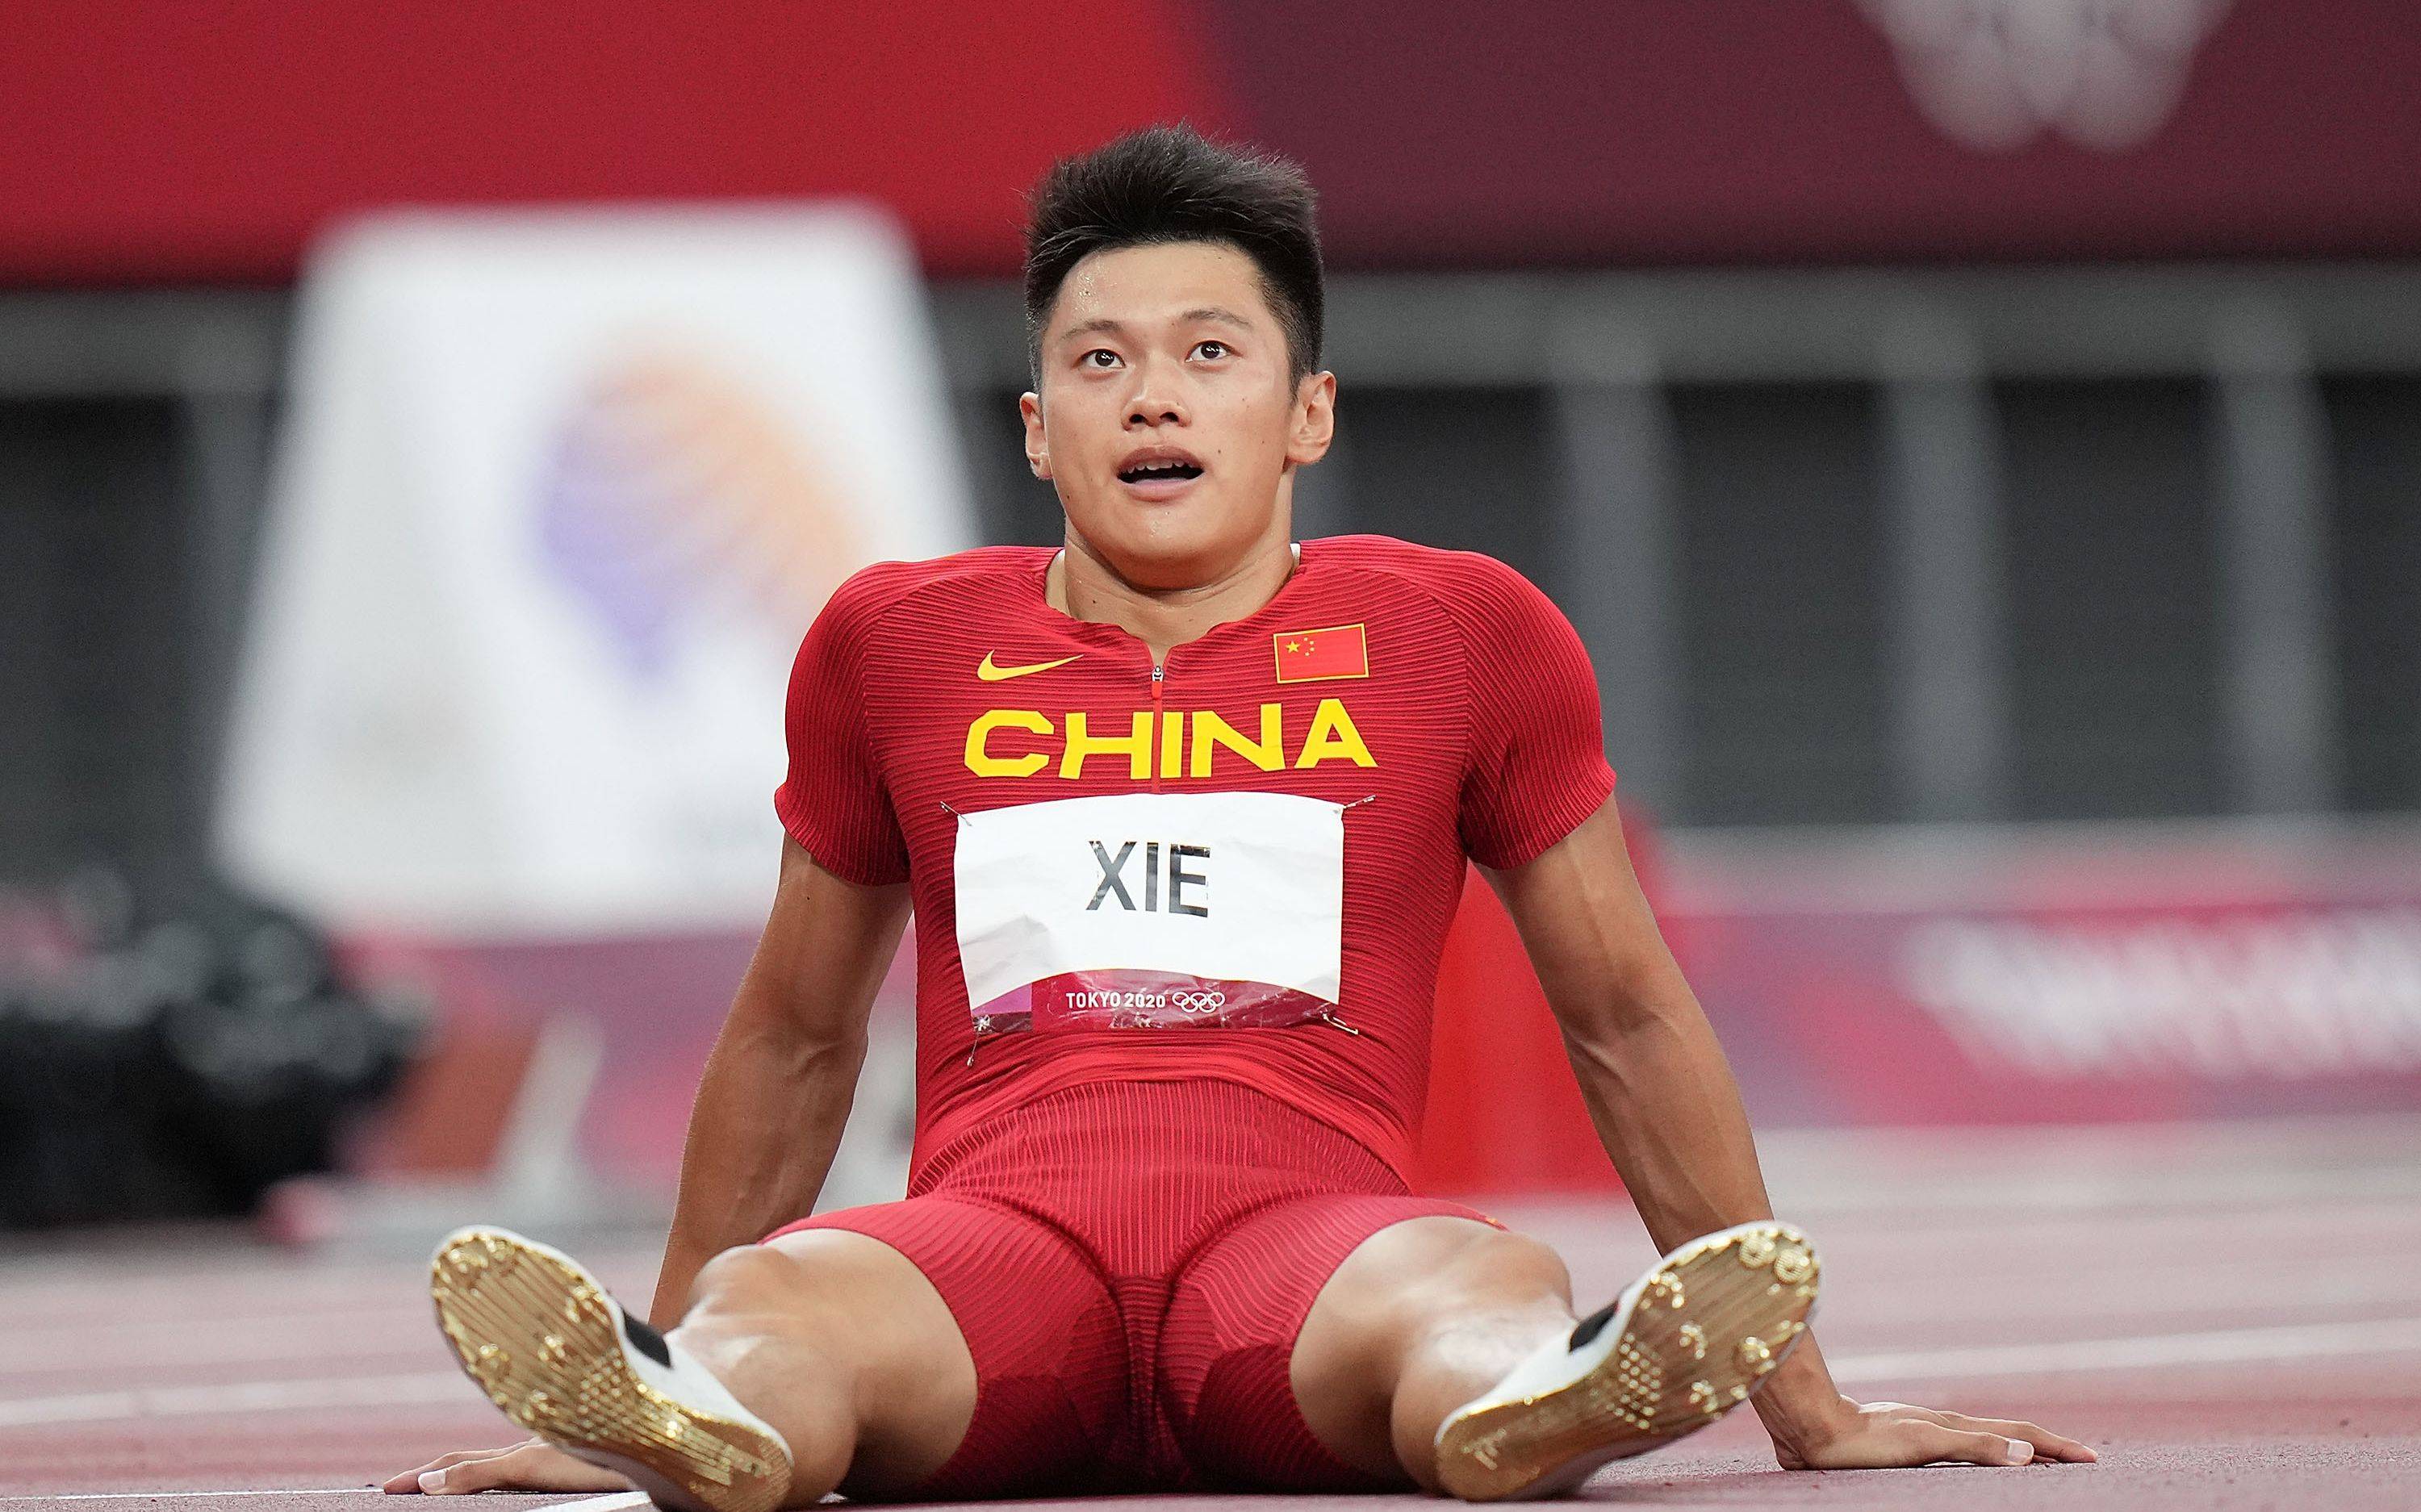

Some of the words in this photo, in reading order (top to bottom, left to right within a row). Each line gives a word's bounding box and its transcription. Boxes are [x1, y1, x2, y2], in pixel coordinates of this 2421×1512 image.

[964, 698, 1378, 779] CHINA
[1085, 840, 1210, 918] XIE
[1066, 992, 1121, 1009] TOKYO
[1123, 992, 1166, 1009] 2020
